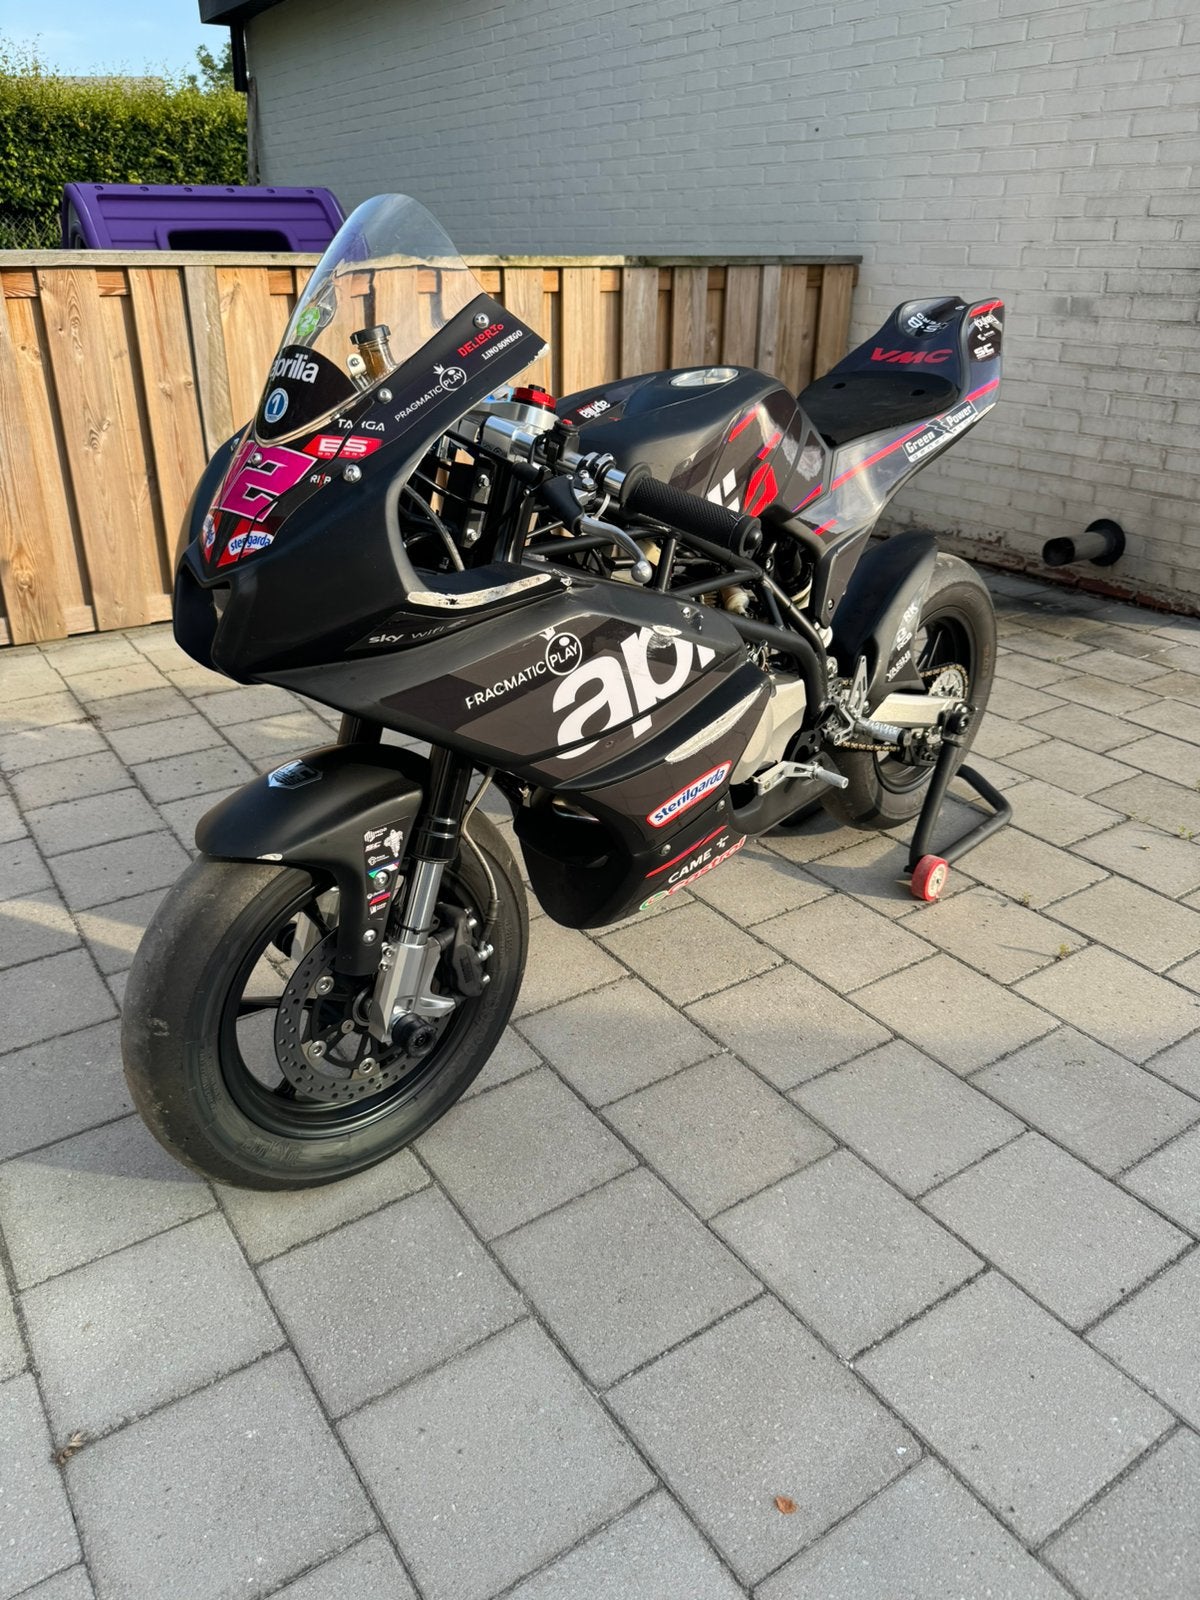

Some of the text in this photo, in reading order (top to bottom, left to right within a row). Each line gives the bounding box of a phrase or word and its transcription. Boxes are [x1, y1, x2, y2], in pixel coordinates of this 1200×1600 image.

[870, 347, 953, 364] VMC
[394, 371, 464, 422] PRAGMATIC PLAY
[945, 405, 972, 427] Power
[318, 437, 368, 453] ES
[904, 430, 936, 454] Green
[368, 633, 404, 644] sky
[549, 642, 578, 668] PLAY
[654, 768, 725, 822] sterilgarda
[668, 848, 712, 884] CAME
